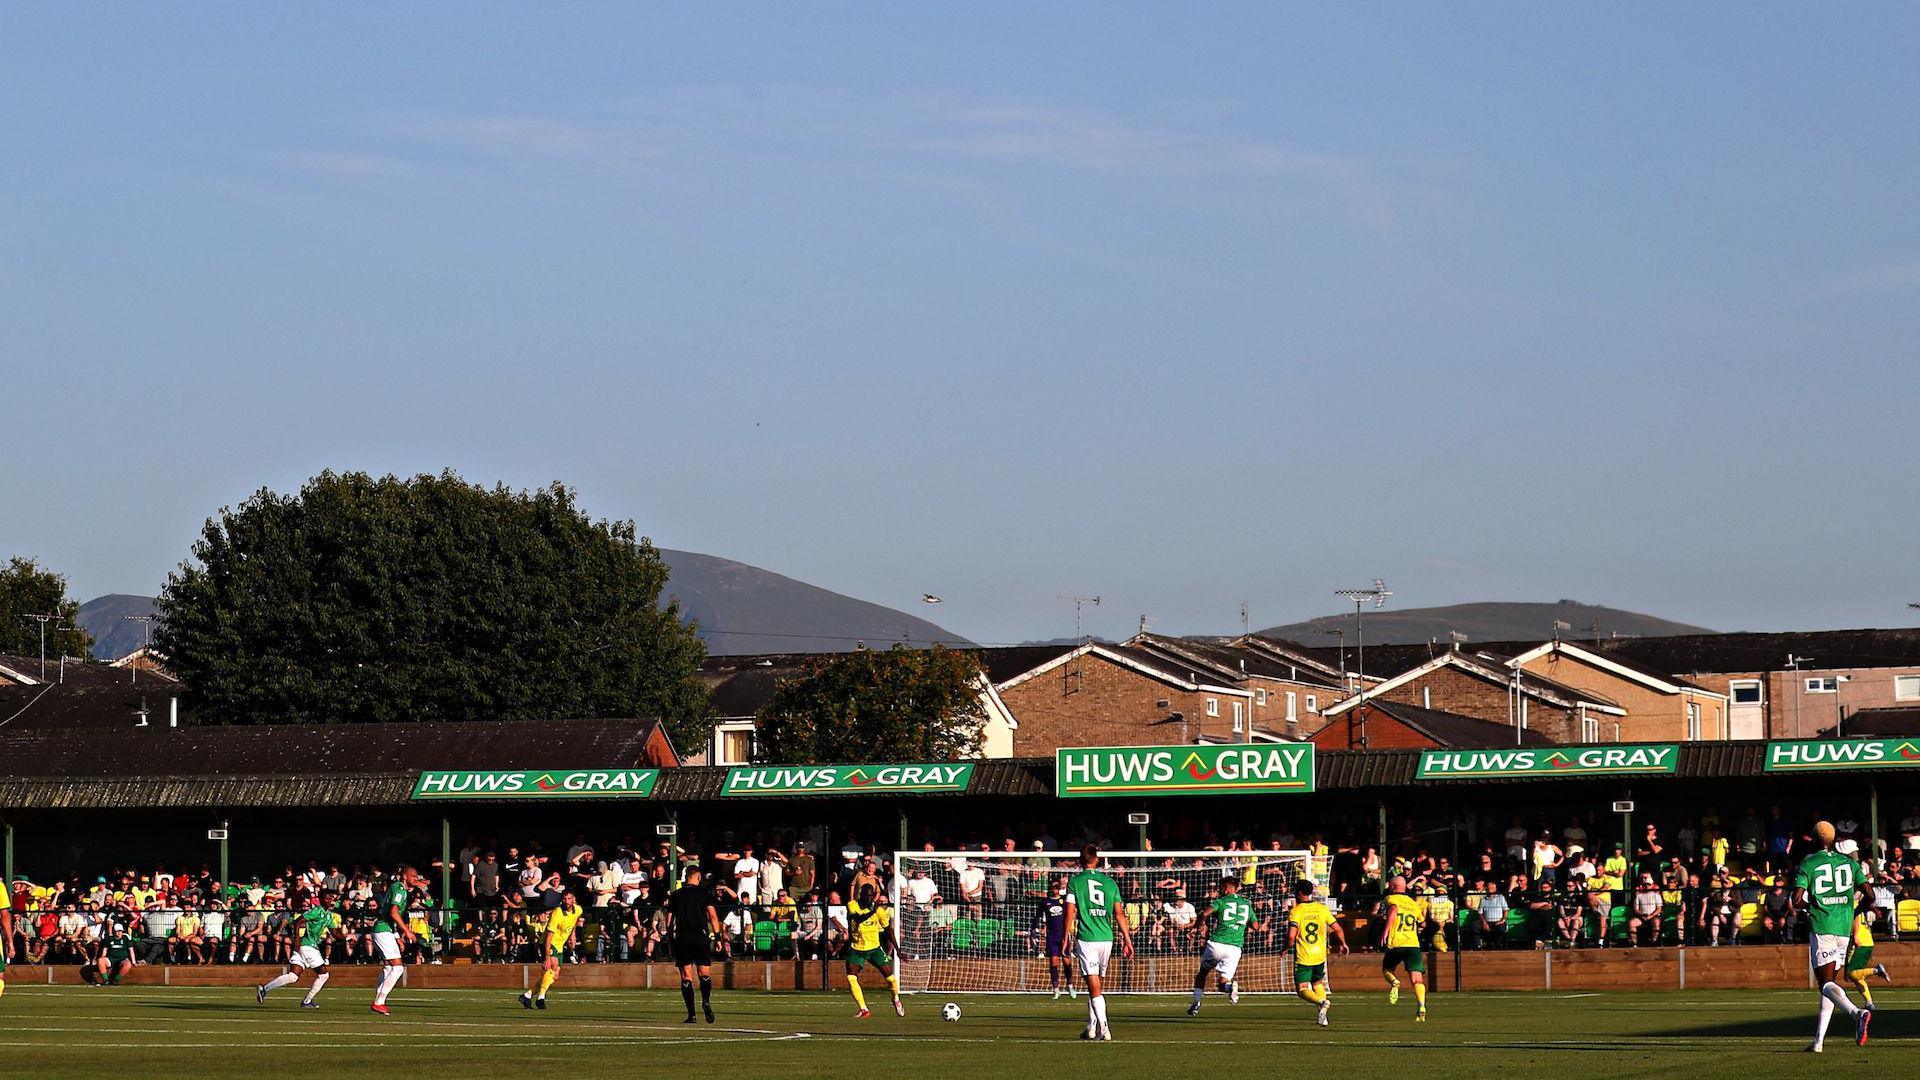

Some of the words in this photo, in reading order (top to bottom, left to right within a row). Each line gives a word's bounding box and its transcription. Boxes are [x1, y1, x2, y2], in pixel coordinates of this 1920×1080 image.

[1424, 751, 1536, 772] HUWS
[1578, 748, 1672, 768] GRAY
[1773, 742, 1885, 763] HUWS
[1066, 751, 1174, 783] HUWS
[1215, 748, 1306, 780] GRAY
[421, 773, 526, 792] HUWS
[563, 772, 652, 792] GRAY
[730, 768, 837, 789] HUWS
[876, 766, 967, 785] GRAY
[1814, 863, 1853, 895] 20
[1087, 879, 1105, 907] 6
[1223, 901, 1250, 927] 23
[1396, 912, 1416, 931] 19
[1305, 922, 1319, 944] 8
